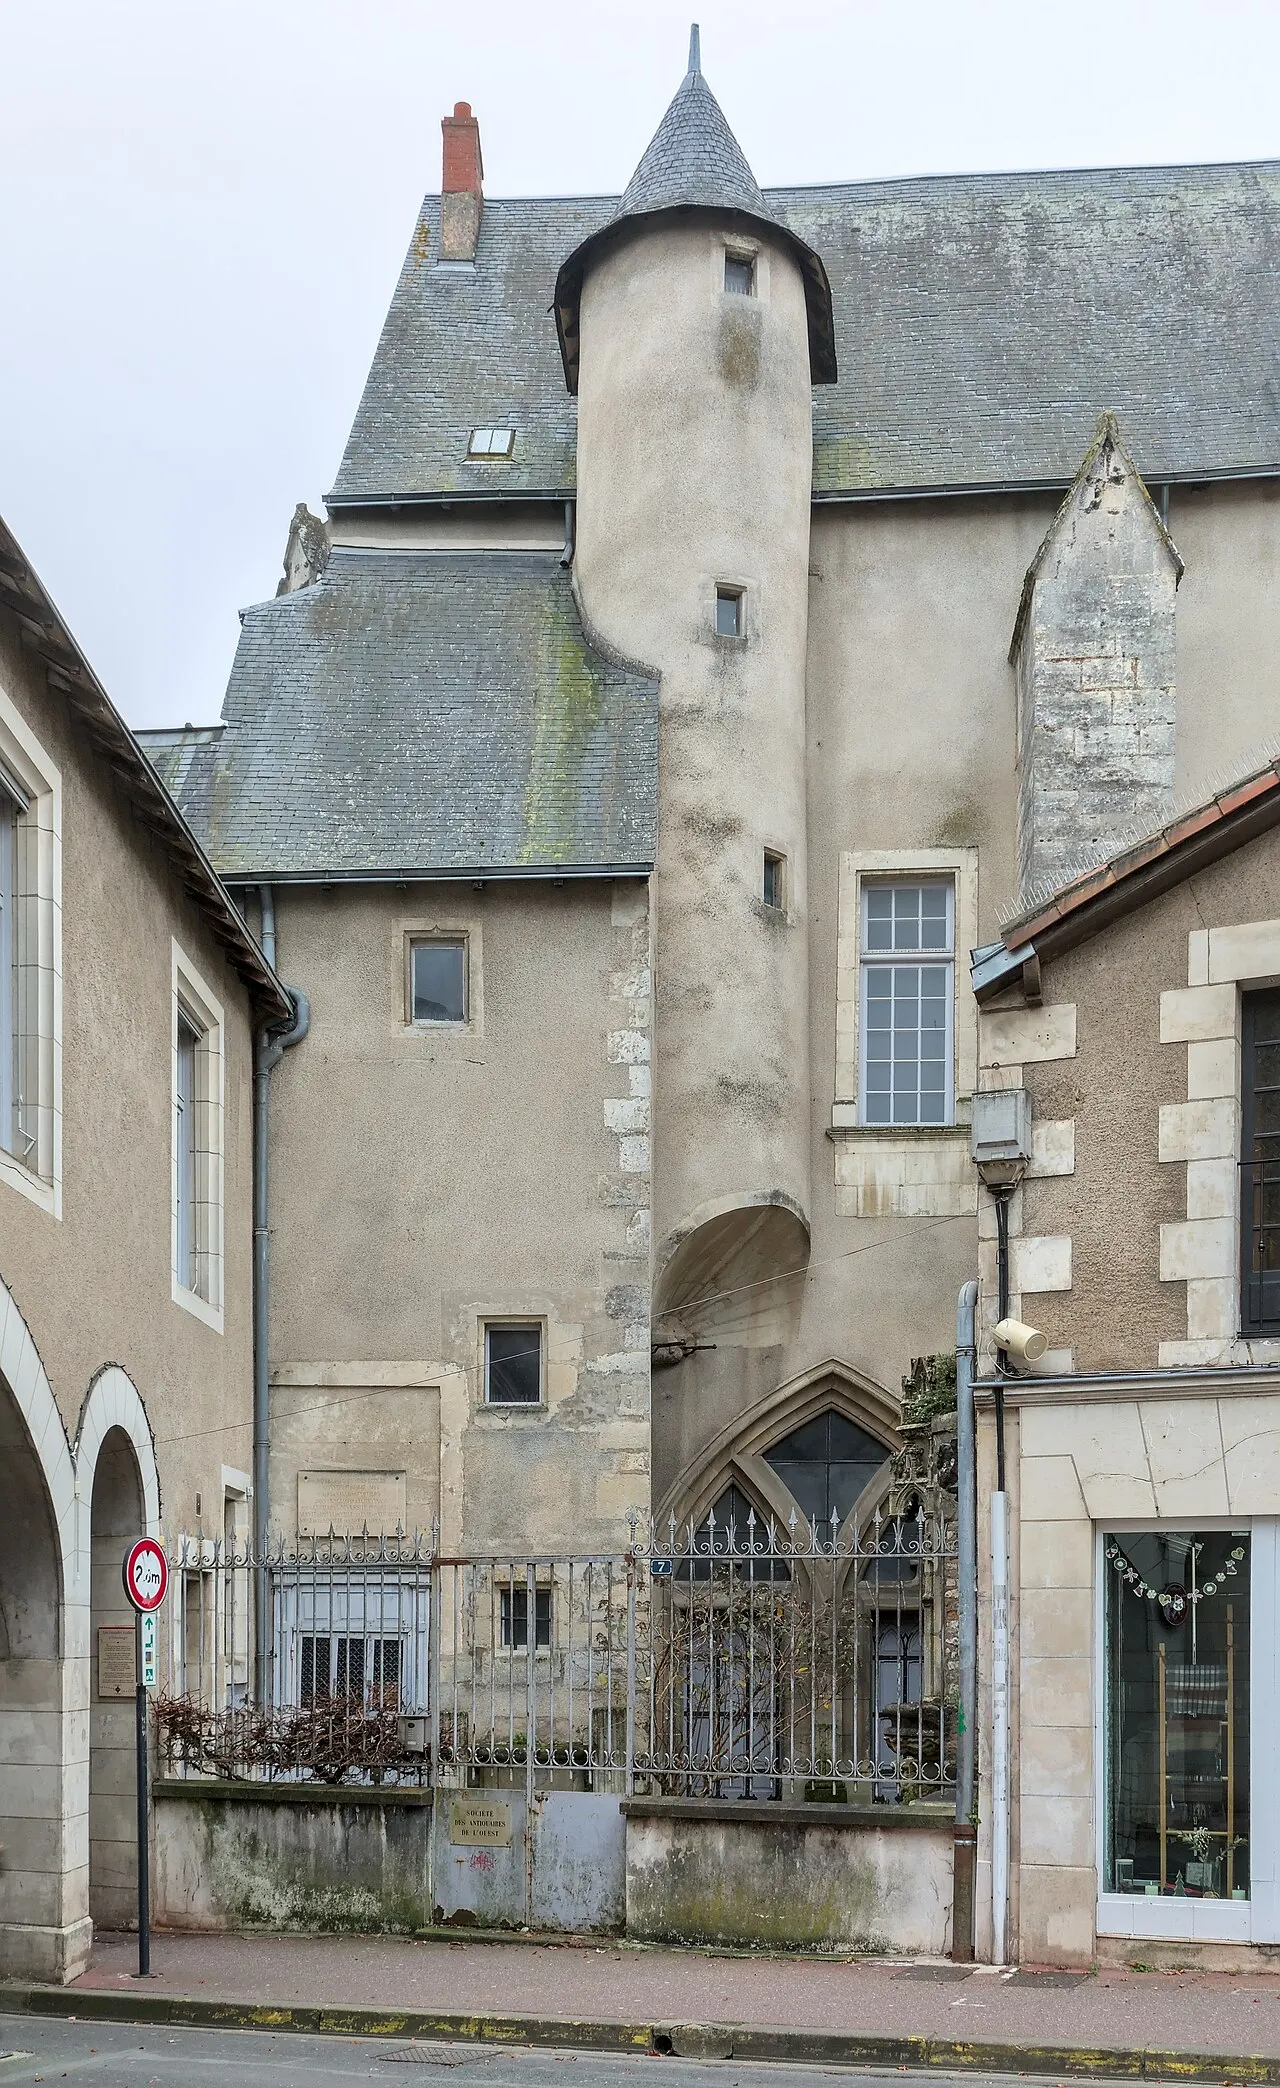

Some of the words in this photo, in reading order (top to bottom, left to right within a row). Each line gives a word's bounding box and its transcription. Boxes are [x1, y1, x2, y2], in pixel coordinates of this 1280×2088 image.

[657, 1561, 666, 1573] 7
[469, 1820, 506, 1828] ANTIQUAIRES
[473, 1829, 499, 1837] L'OUEST
